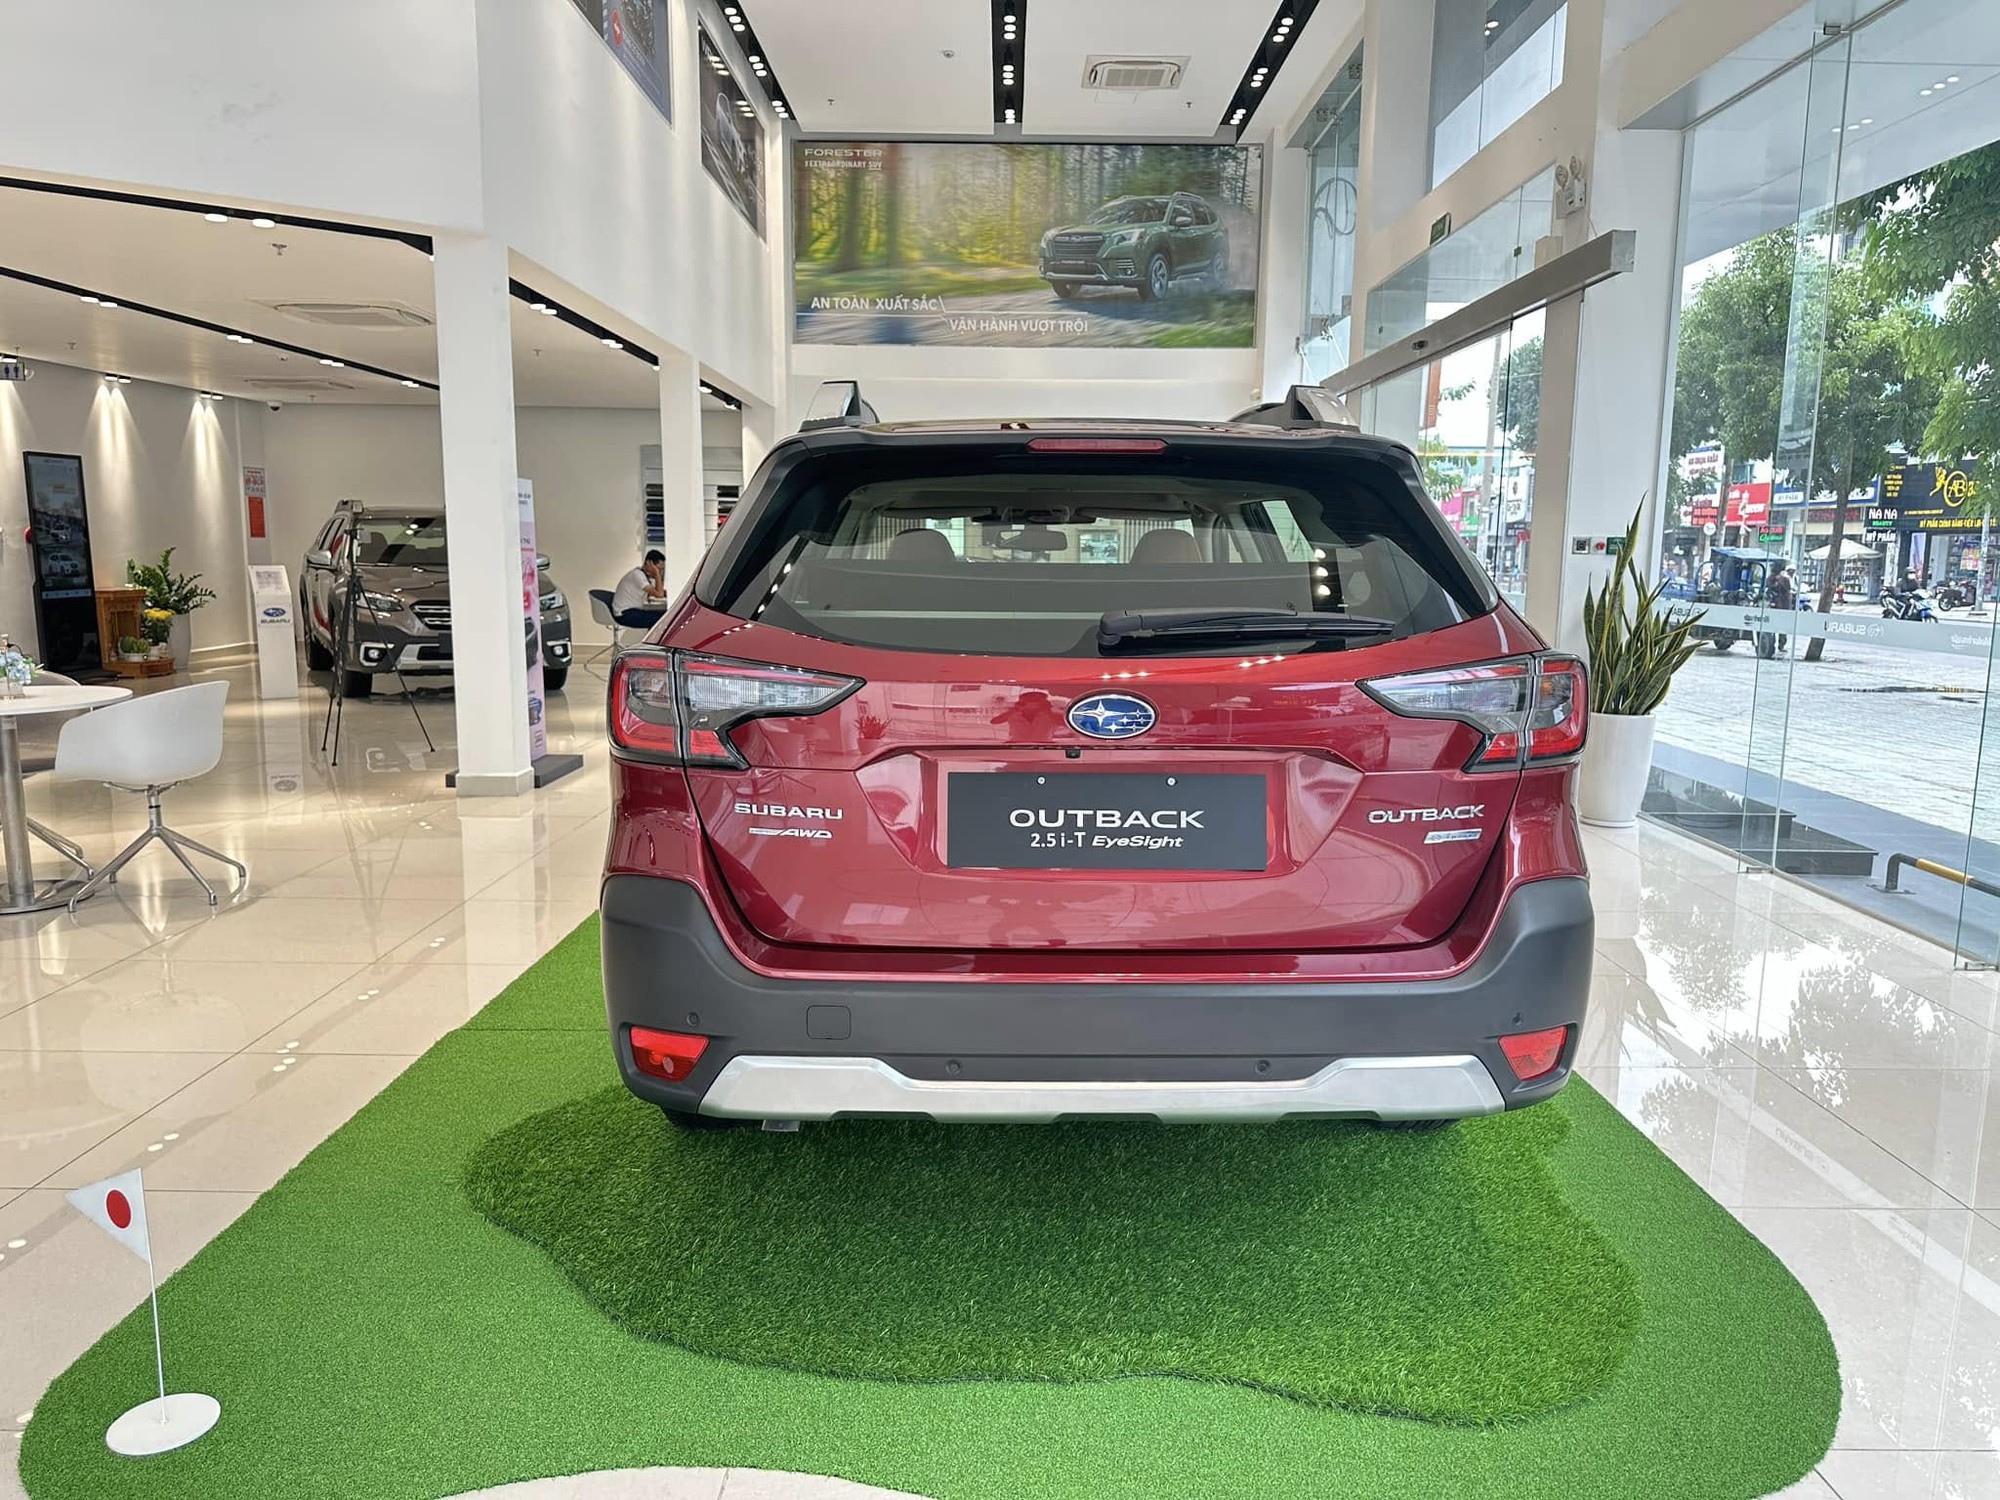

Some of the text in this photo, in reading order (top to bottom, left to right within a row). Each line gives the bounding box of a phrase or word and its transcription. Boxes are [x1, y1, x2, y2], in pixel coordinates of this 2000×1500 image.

[804, 149, 882, 157] FORESTER
[811, 294, 937, 310] AN TOÀN XUẤT SẮC
[950, 318, 1088, 334] VẬN HÀNH VƯỢT TRỘI
[1869, 508, 1882, 520] NA
[1884, 508, 1898, 520] NA
[734, 802, 843, 819] SUBARU
[1368, 804, 1485, 824] OUTBACK
[1009, 809, 1205, 829] OUTBACK
[780, 828, 833, 839] AWD
[1091, 834, 1184, 850] EyeSight
